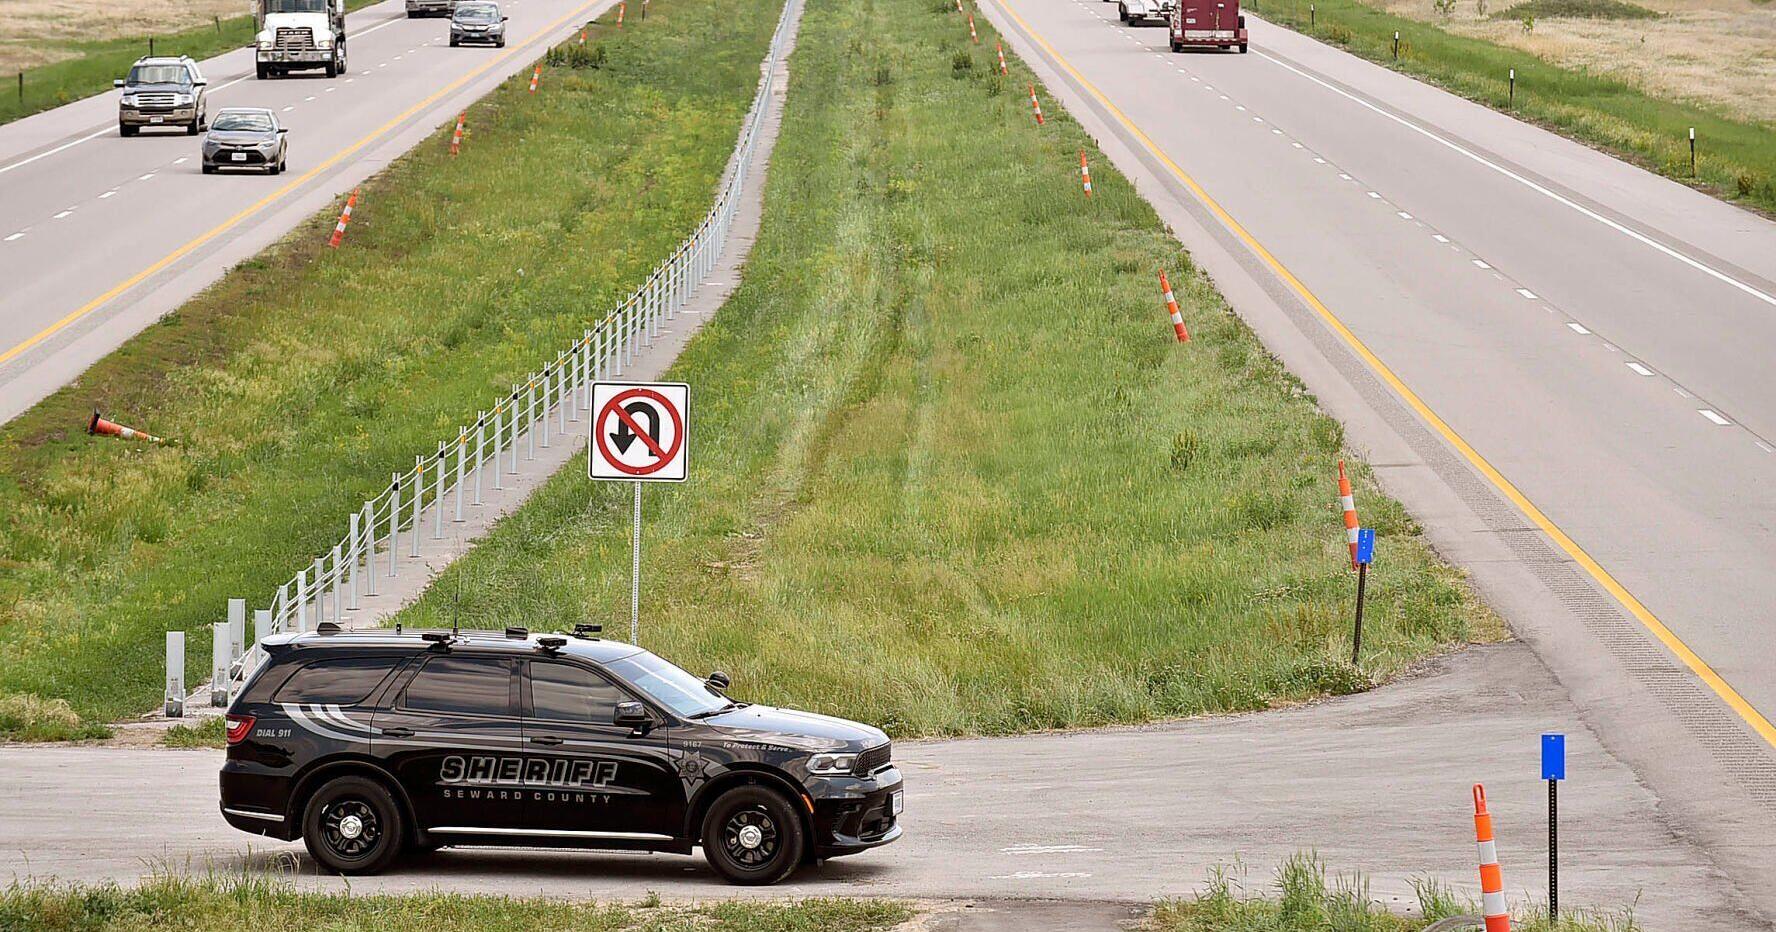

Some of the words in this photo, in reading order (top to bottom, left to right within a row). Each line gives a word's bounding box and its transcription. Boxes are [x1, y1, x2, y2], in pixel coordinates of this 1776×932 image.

[256, 729, 276, 737] DIAL
[278, 729, 291, 738] 911
[731, 742, 759, 750] Protect
[439, 755, 618, 787] SHERIFF
[443, 789, 522, 800] SEWARD
[533, 792, 611, 803] COUNTY
